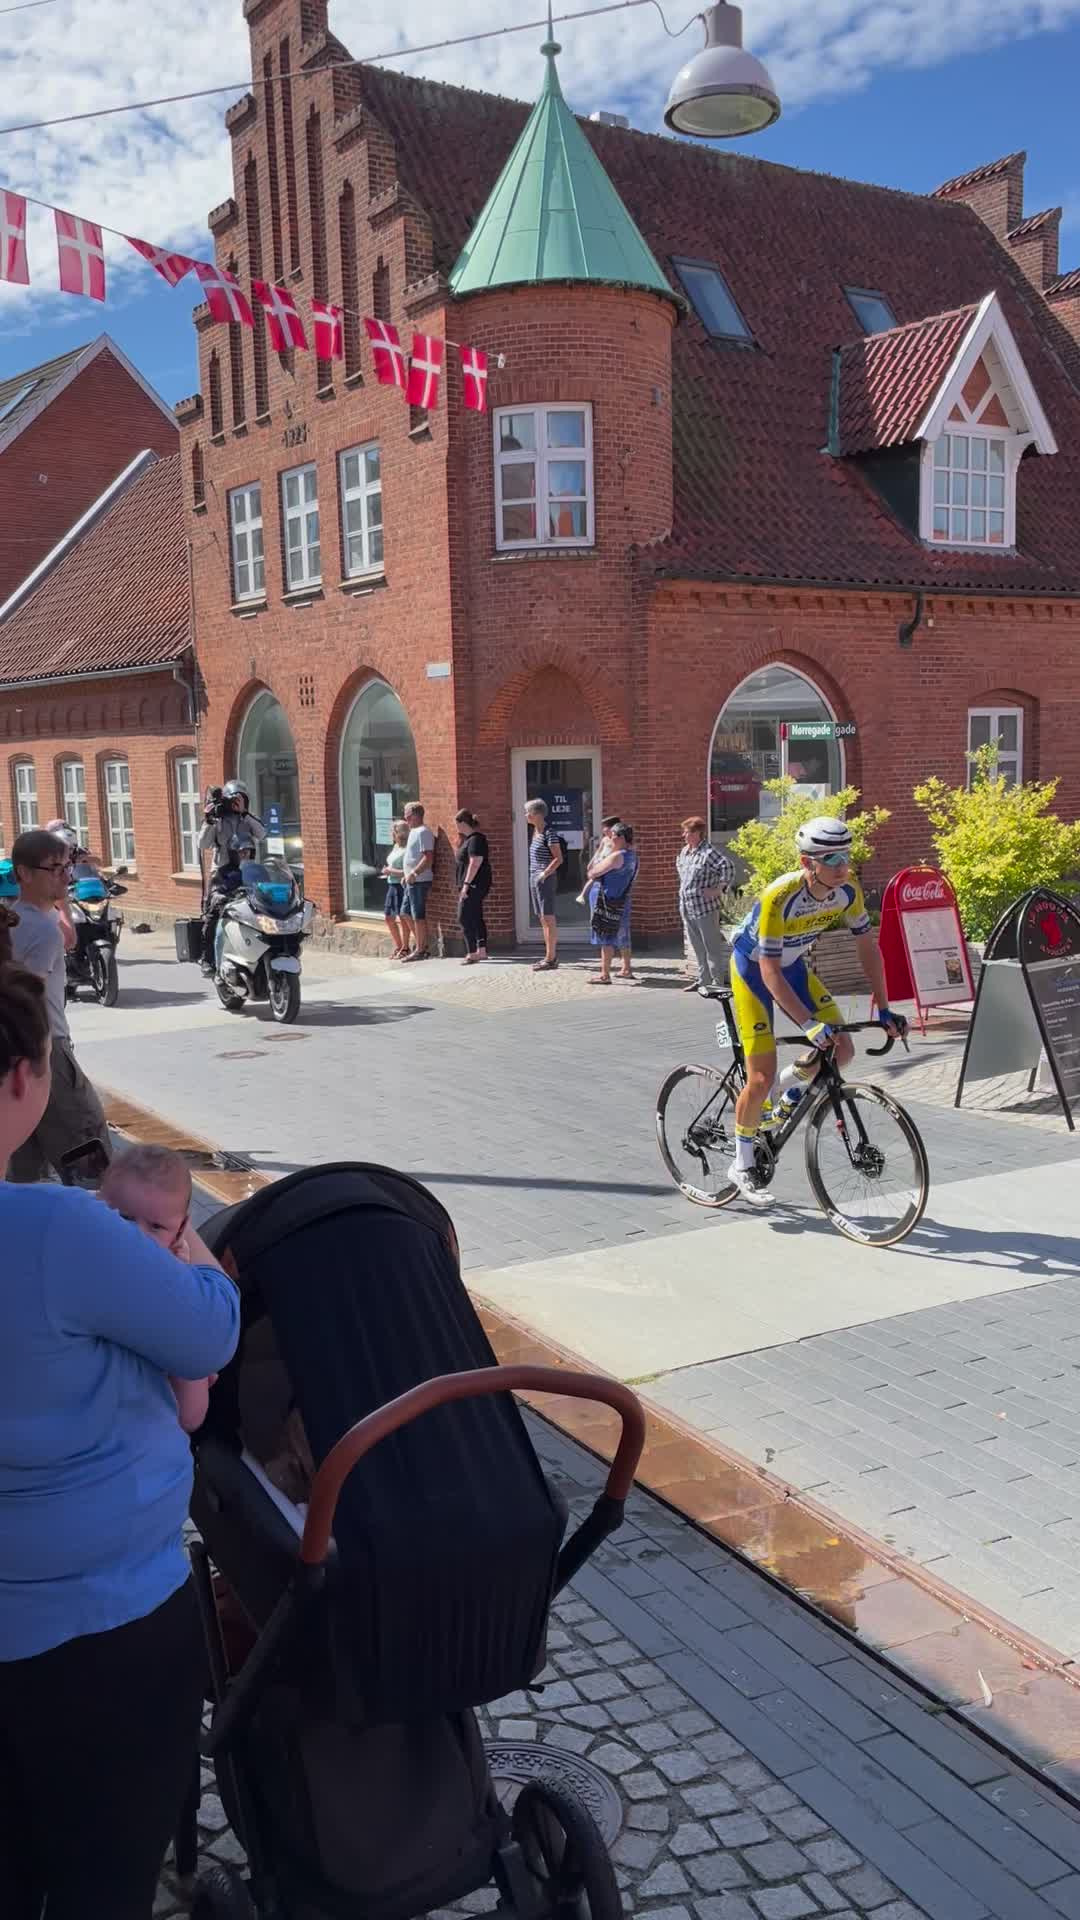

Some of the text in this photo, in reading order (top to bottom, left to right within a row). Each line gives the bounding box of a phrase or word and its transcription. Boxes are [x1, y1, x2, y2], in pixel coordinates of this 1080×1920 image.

[554, 795, 567, 803] TIL
[551, 805, 571, 814] LEJE
[902, 880, 944, 902] Coca-Cola
[716, 1023, 728, 1046] 125
